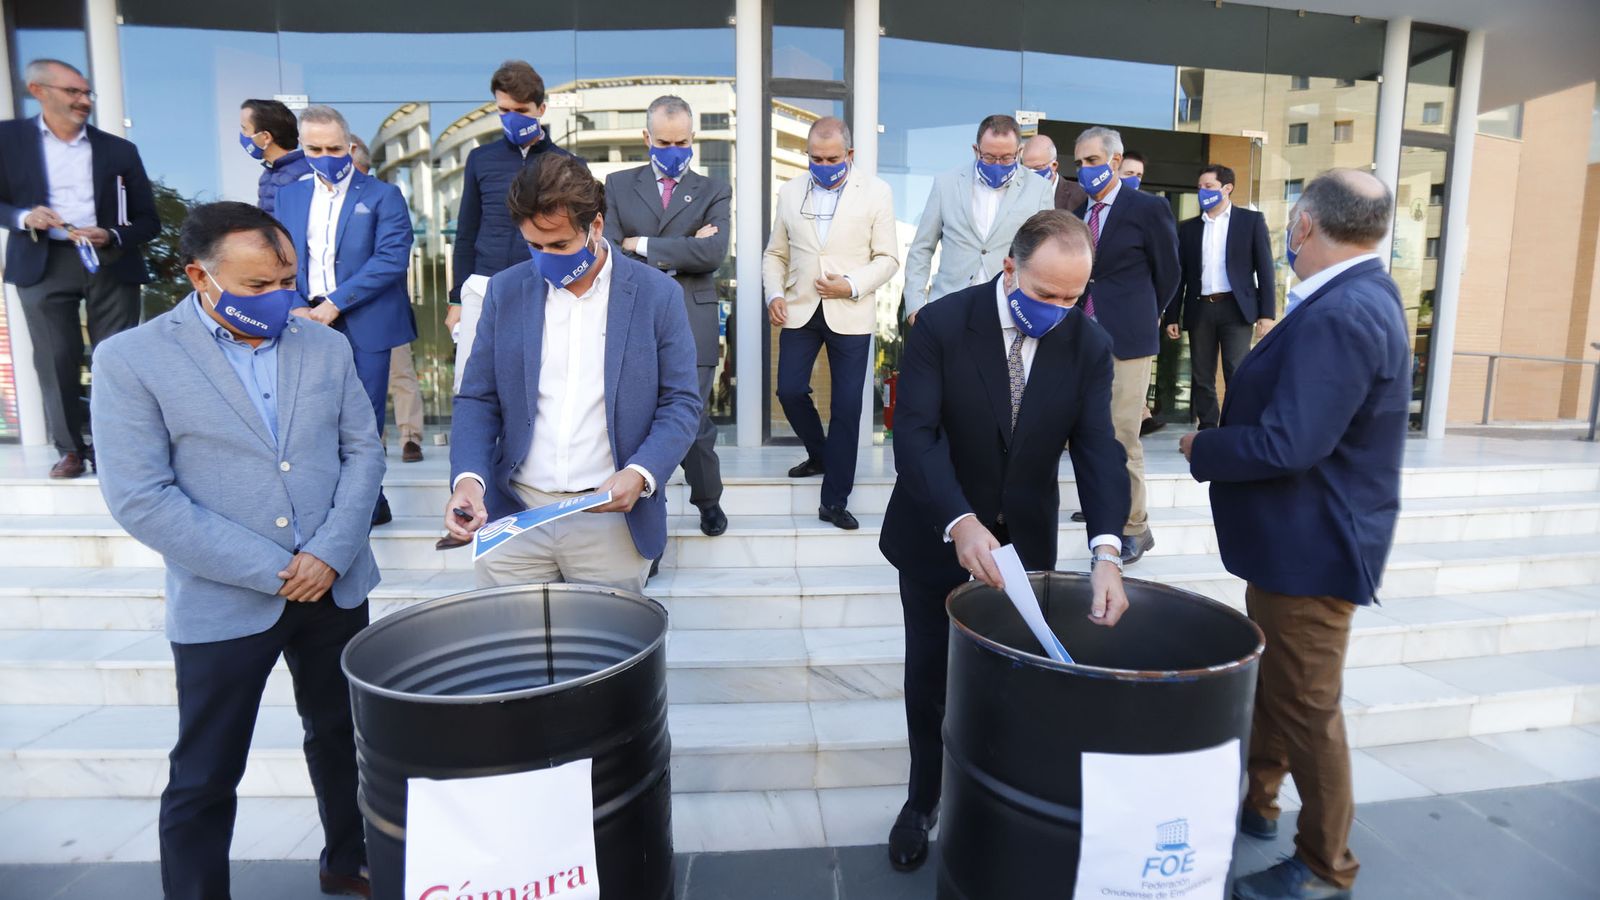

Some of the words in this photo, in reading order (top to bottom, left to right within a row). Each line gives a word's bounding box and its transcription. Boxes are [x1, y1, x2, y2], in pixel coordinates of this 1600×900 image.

[572, 260, 589, 277] FOE
[225, 306, 269, 330] Cámara
[1010, 299, 1033, 330] Cámara
[1142, 850, 1196, 878] FOE
